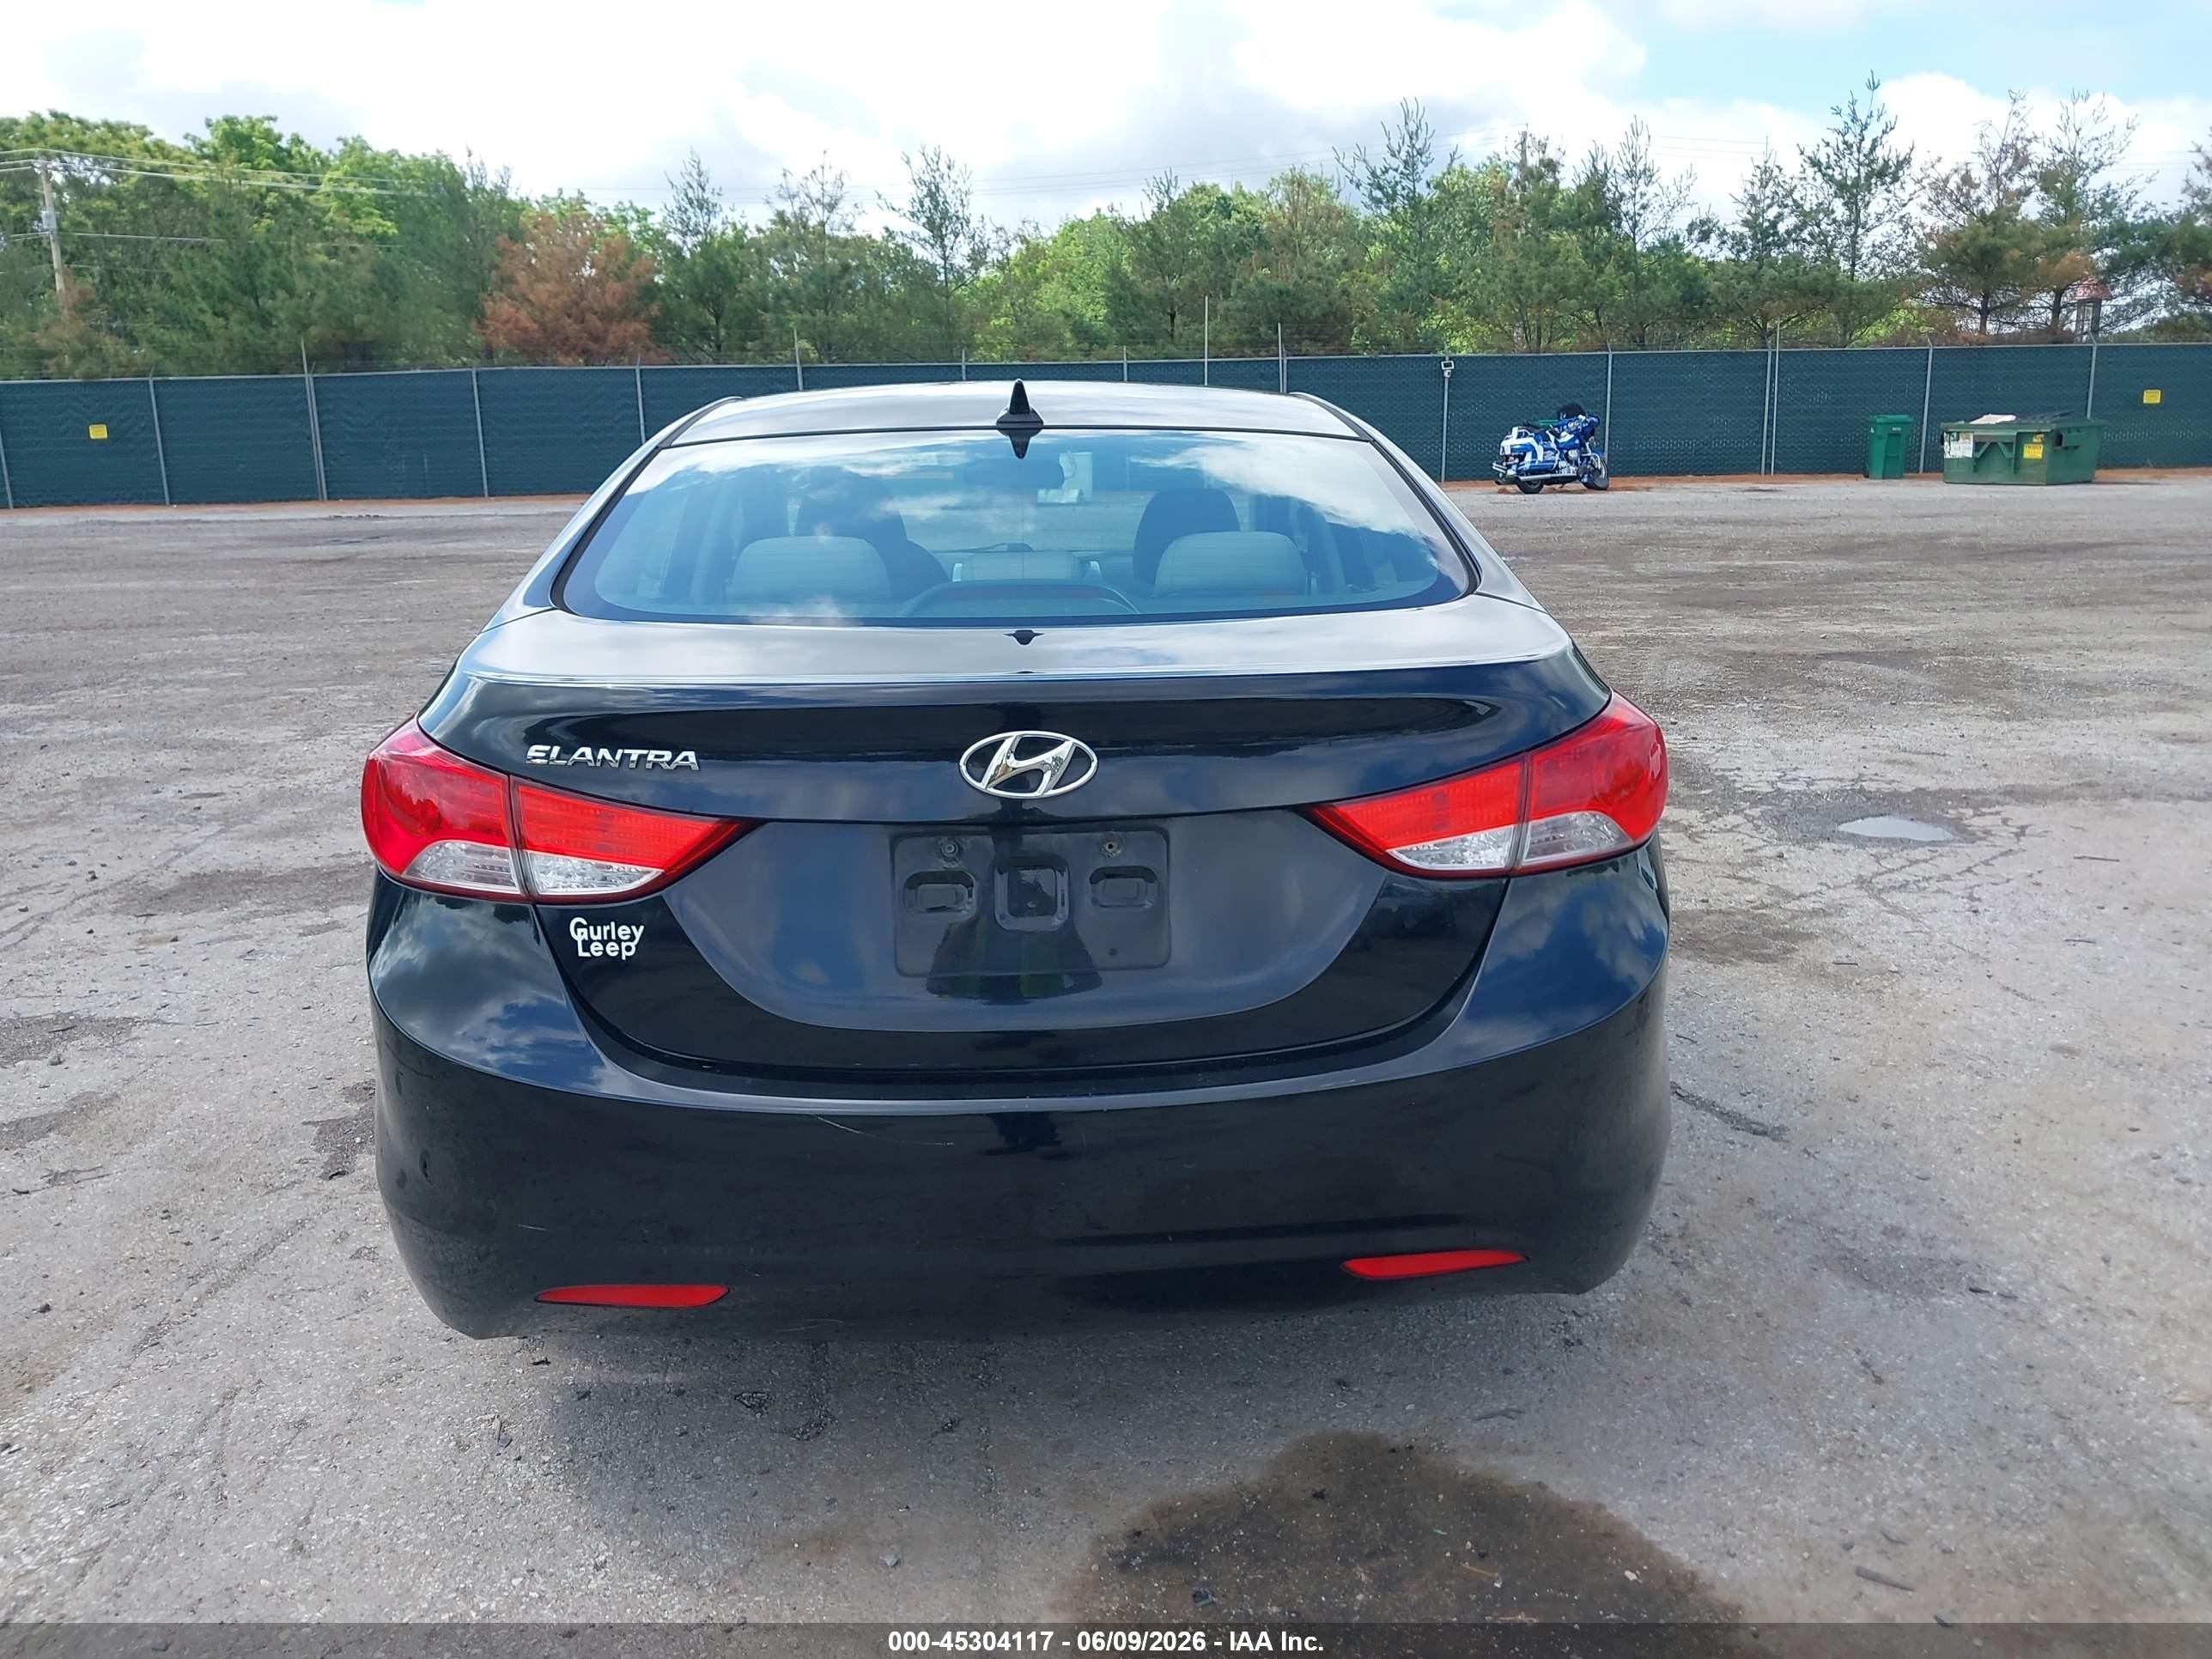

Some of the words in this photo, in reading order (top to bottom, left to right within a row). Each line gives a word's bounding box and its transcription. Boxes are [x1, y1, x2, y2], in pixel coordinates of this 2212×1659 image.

[526, 744, 701, 771] ELANTRA
[569, 916, 645, 945] Gurley
[577, 935, 636, 960] Leep
